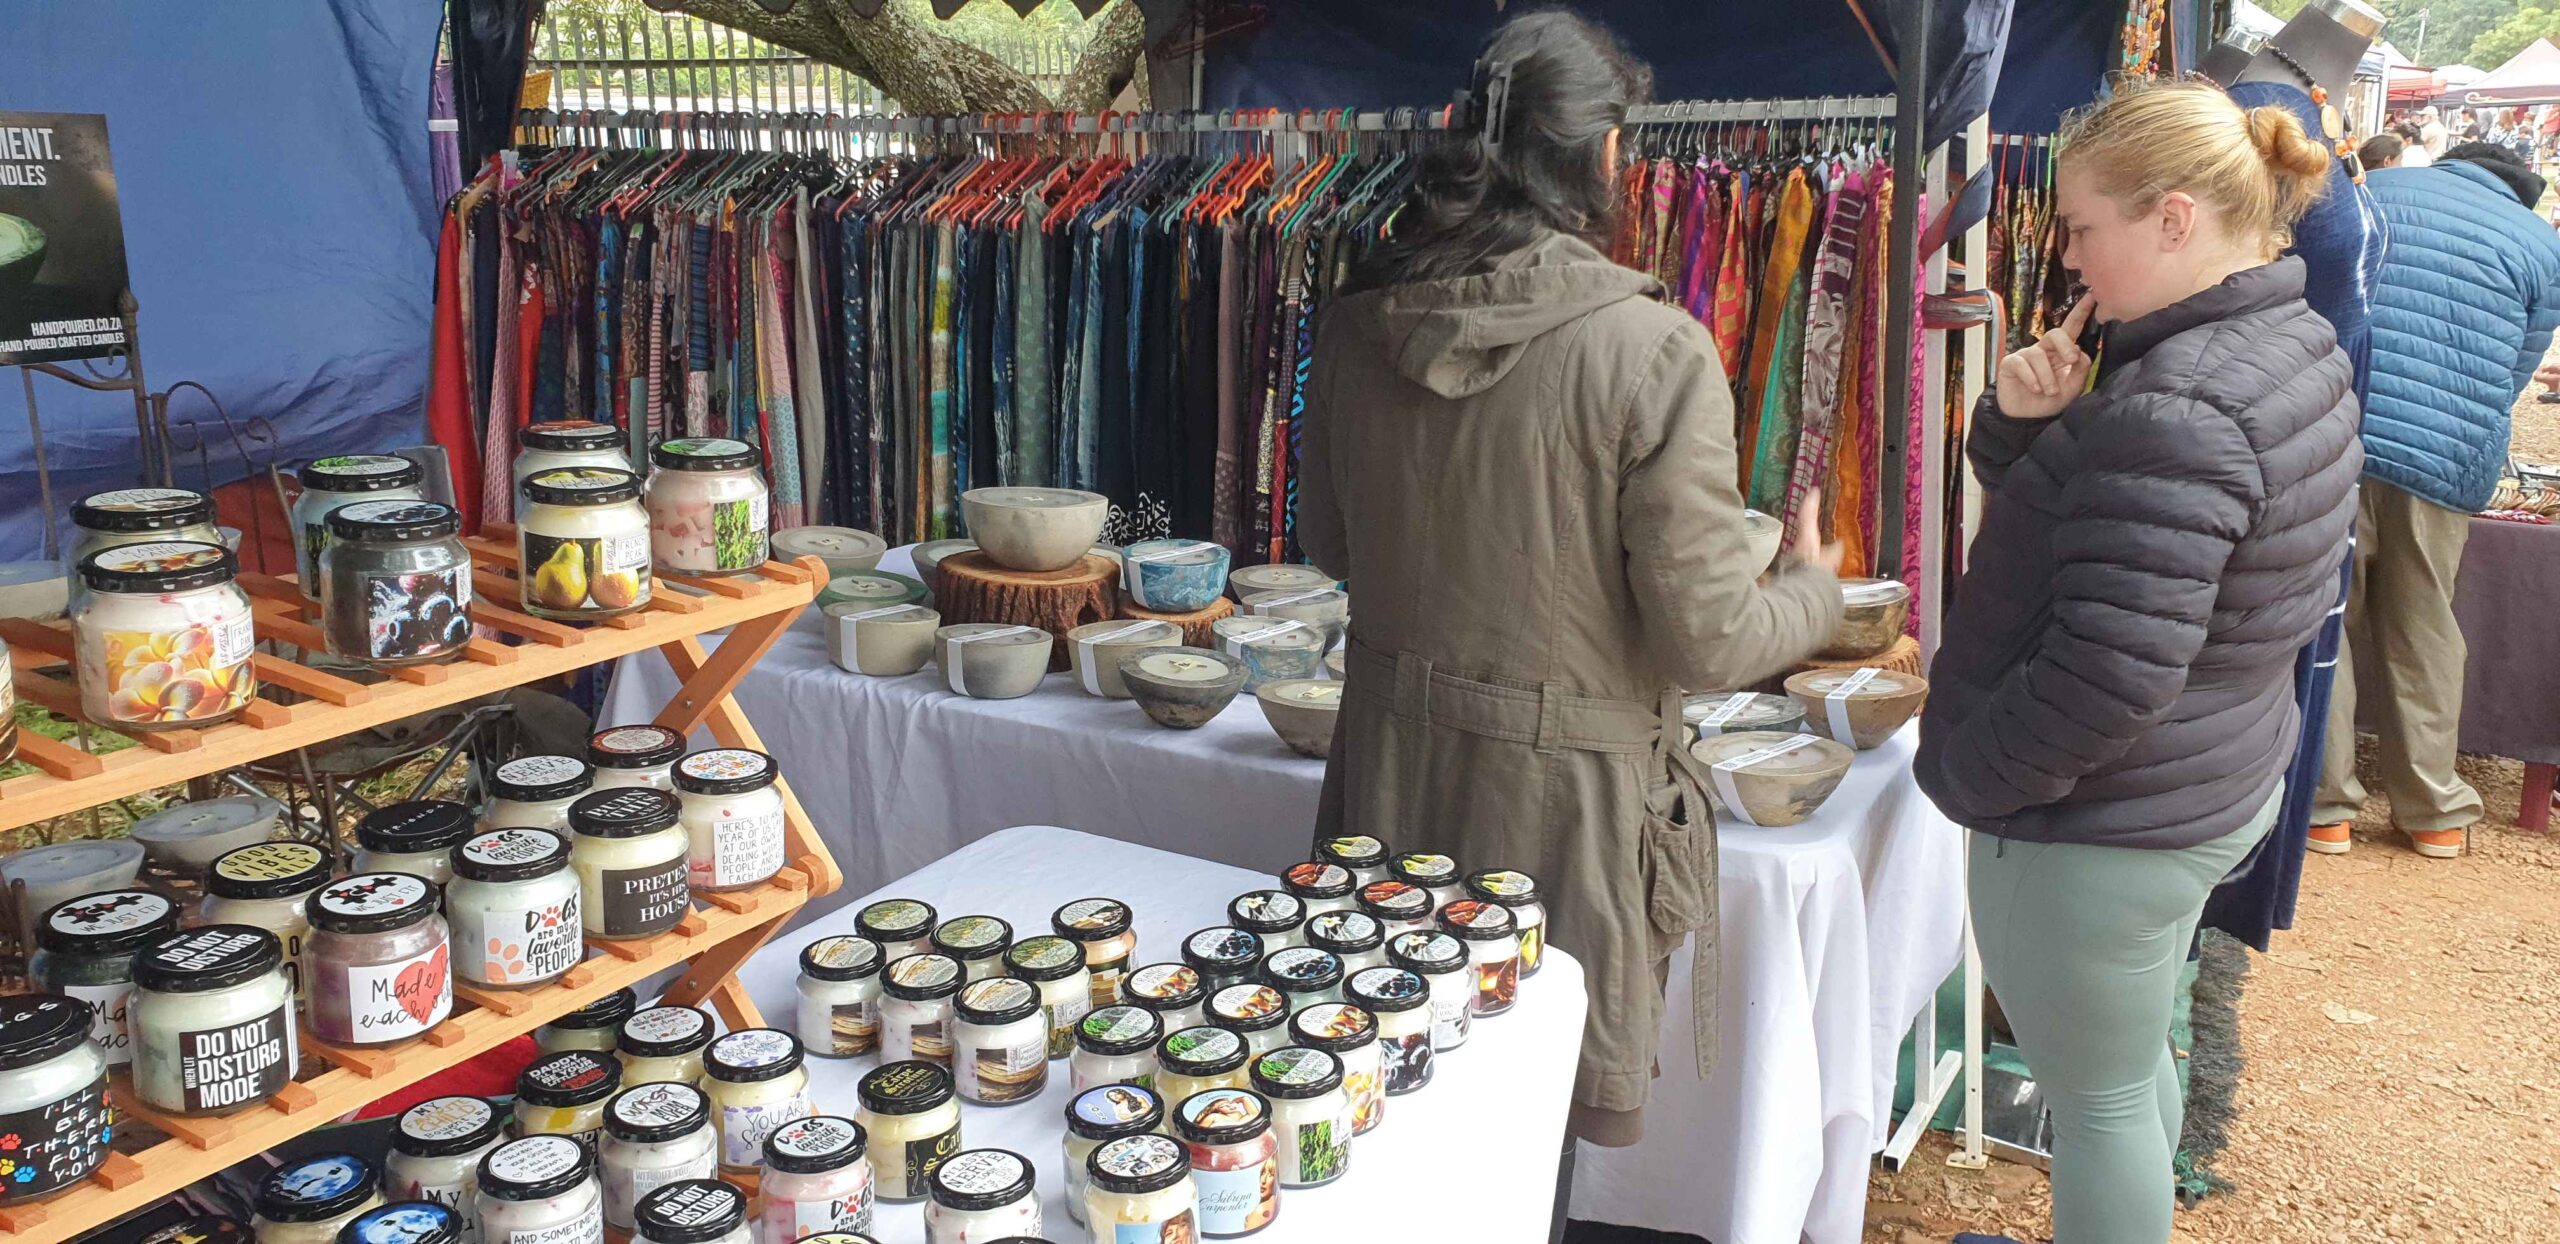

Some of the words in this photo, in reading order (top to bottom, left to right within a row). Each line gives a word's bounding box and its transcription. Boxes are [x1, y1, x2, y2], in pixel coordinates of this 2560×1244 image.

[31, 317, 123, 337] HANDPOURED.CO.ZA
[23, 337, 57, 351] POURED
[58, 334, 92, 348] CRAFTED
[92, 332, 125, 345] CANDLES
[585, 789, 650, 817] BURN
[605, 795, 662, 818] THIS
[638, 803, 662, 816] AND
[220, 844, 279, 867] GOOD
[738, 839, 758, 851] OUR
[228, 846, 312, 877] VIBES
[262, 857, 317, 879] ONLY
[722, 851, 759, 865] DEALING
[722, 862, 755, 875] PEOPLE
[728, 873, 754, 885] EACH
[537, 929, 554, 940] are
[156, 947, 191, 963] DO
[187, 930, 232, 950] NOT
[176, 932, 263, 971] DISTURB
[535, 941, 578, 976] PEOPLE
[371, 967, 437, 1003] Made
[88, 1000, 127, 1025] Ma
[359, 1000, 426, 1029] each
[195, 1031, 226, 1059] DO
[230, 1017, 270, 1053] NOT
[183, 1056, 196, 1068] LIT
[197, 1037, 281, 1084] DISTURB
[529, 1052, 578, 1078] DADDY
[540, 1074, 559, 1085] BE
[558, 1059, 595, 1079] YOUR
[551, 1056, 588, 1075] ALWAYS
[184, 1067, 197, 1089] WHEN
[200, 1072, 262, 1109] MODE
[620, 1085, 674, 1117] WORST
[413, 1101, 441, 1117] MY
[650, 1099, 684, 1117] MOM
[661, 1104, 697, 1122] EVER
[745, 1109, 781, 1133] YOU
[635, 1168, 674, 1182] WITHOUT
[945, 1152, 1006, 1189] NERVE
[653, 1199, 684, 1217] DO
[673, 1184, 711, 1204] NOT
[669, 1188, 734, 1226] DISTURB
[1198, 1197, 1248, 1215] Carpenter
[1208, 1190, 1253, 1206] Sabrina
[513, 1233, 538, 1244] AND
[541, 1210, 597, 1243] SOMETIMES
[840, 1214, 855, 1225] are
